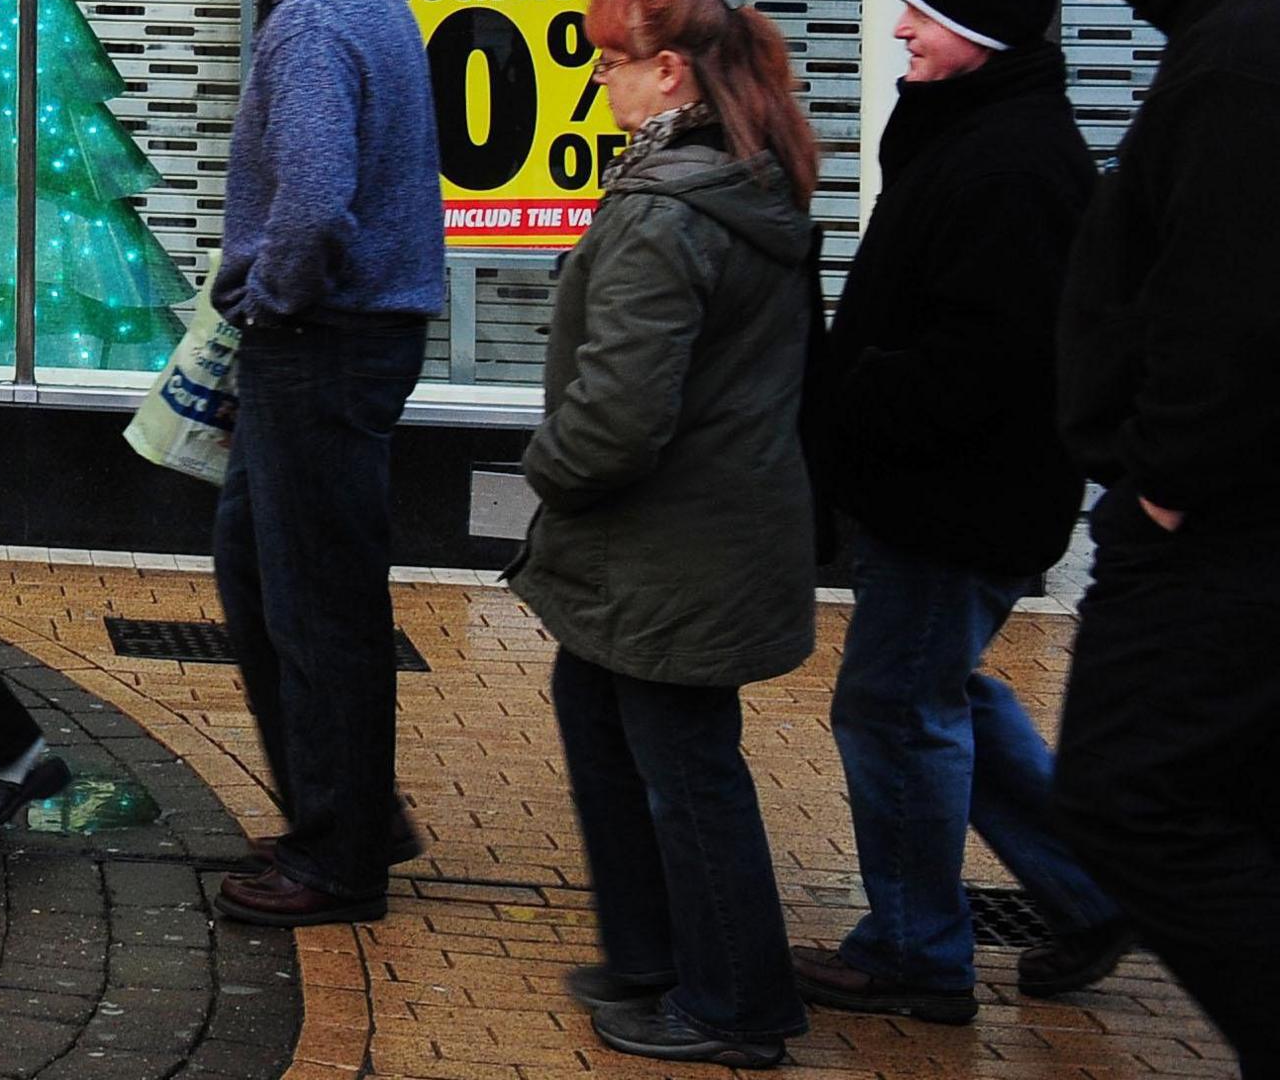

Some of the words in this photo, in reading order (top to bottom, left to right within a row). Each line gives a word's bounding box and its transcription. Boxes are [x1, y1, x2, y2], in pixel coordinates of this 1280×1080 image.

[443, 208, 523, 229] INCLUDE
[526, 208, 564, 228] THE
[566, 208, 596, 228] VA
